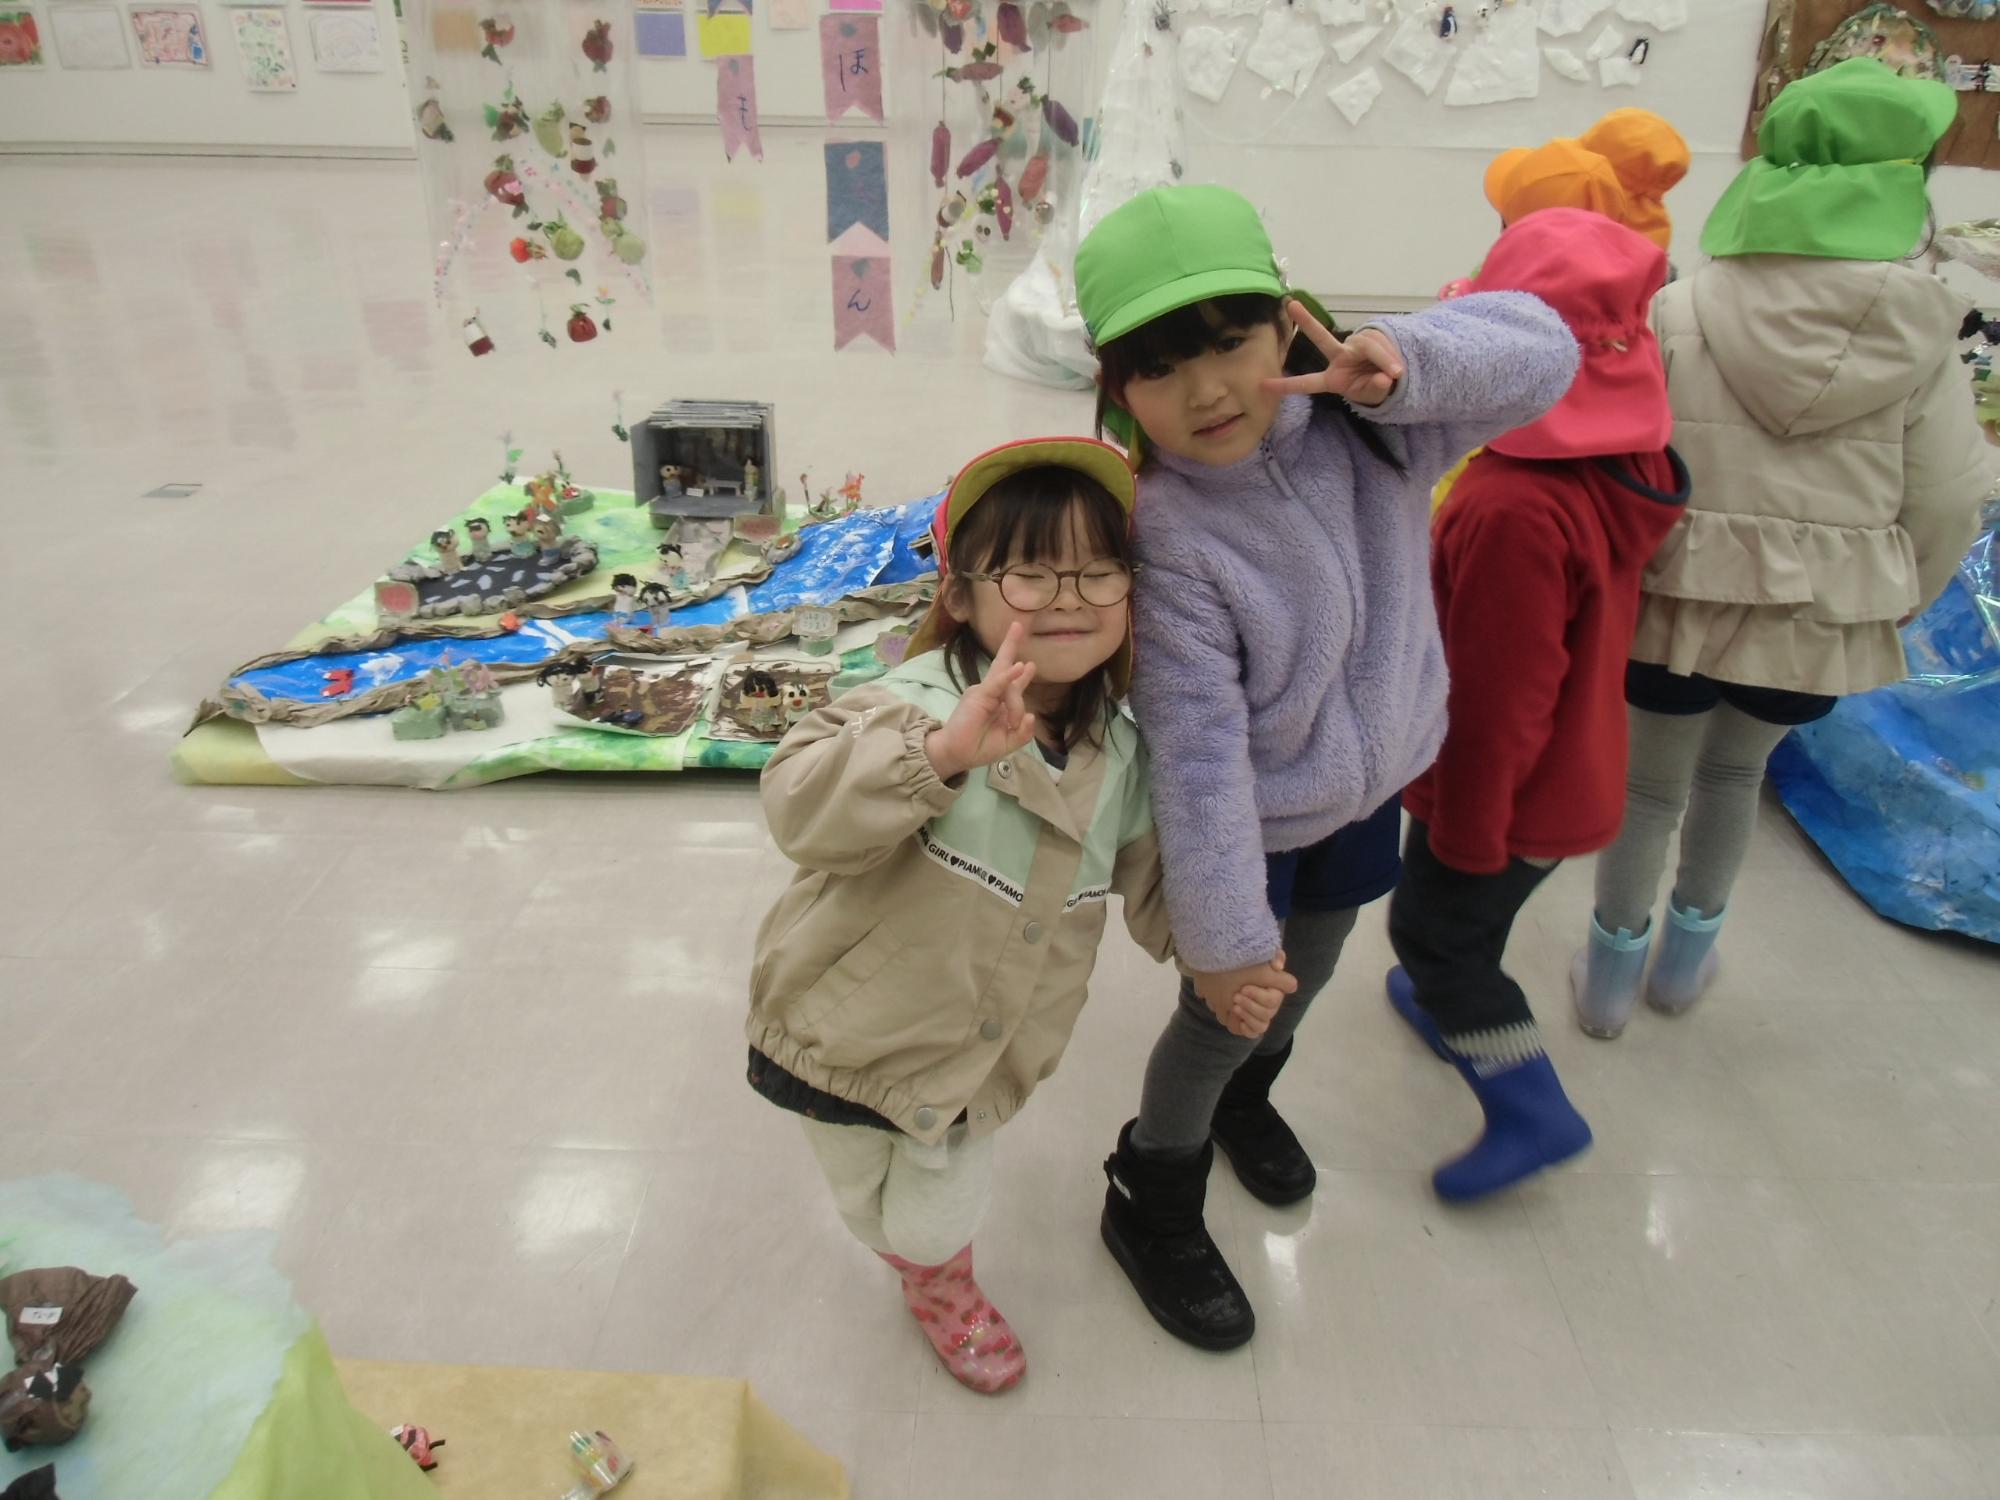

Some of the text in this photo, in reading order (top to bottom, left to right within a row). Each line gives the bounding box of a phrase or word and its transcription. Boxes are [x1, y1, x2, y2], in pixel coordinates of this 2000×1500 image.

[838, 48, 869, 92] ほ
[847, 288, 871, 312] ん
[928, 843, 950, 863] GIRL
[994, 879, 1024, 903] PIAMO
